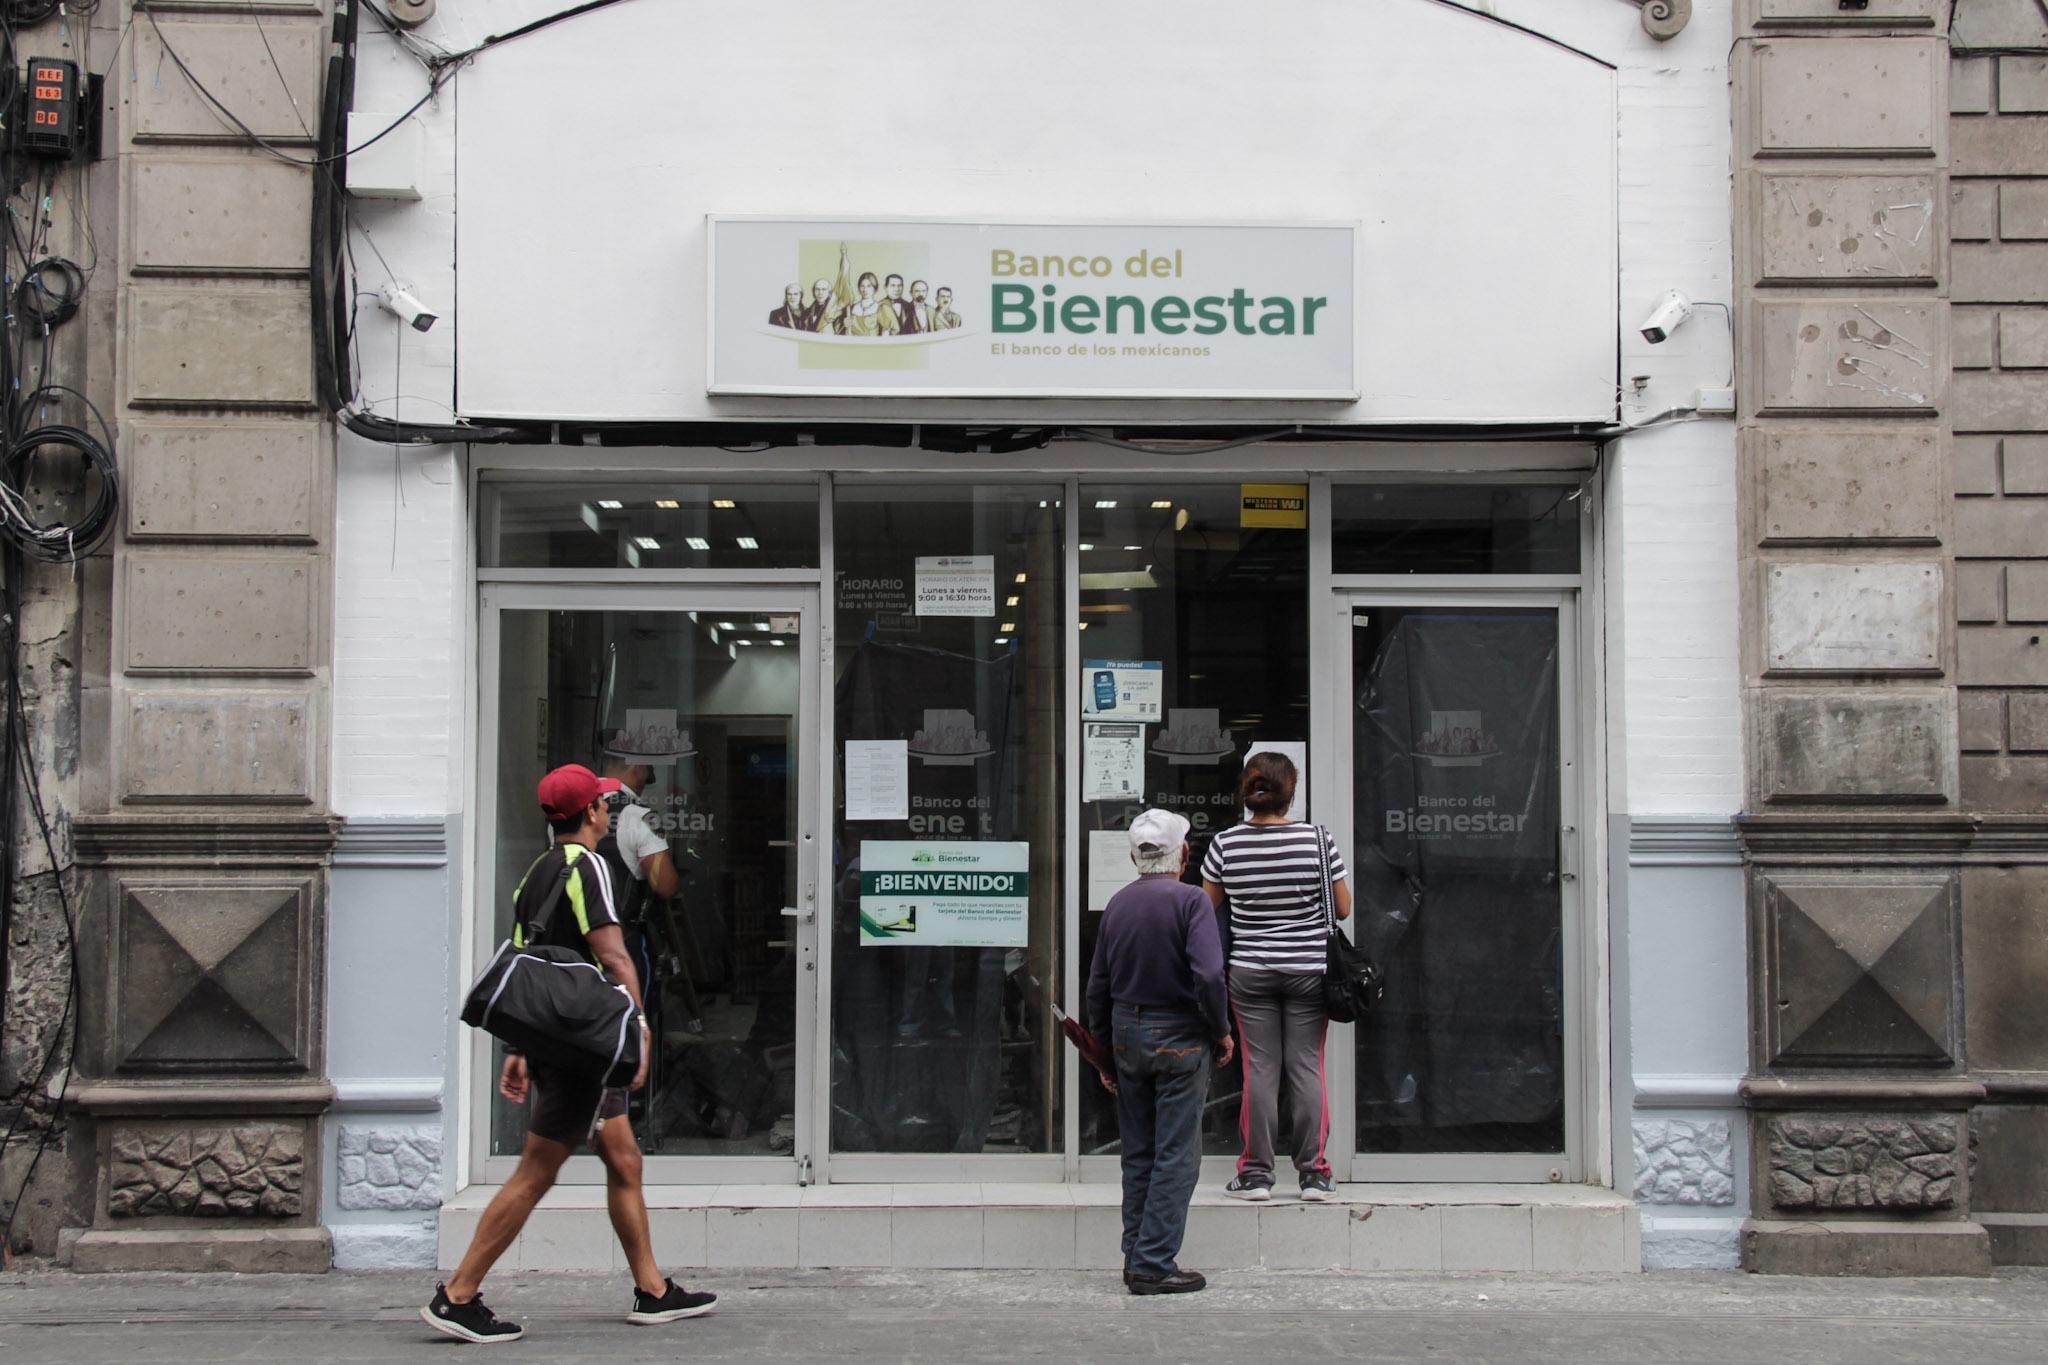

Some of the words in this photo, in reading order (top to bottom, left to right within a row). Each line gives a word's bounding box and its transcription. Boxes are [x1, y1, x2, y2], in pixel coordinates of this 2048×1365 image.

[38, 70, 62, 80] REF
[38, 88, 60, 98] 163
[991, 249, 1112, 278] Banco
[1124, 249, 1183, 278] del
[991, 283, 1327, 336] Bienestar
[990, 343, 1006, 356] El
[1011, 342, 1062, 356] banco
[1067, 343, 1088, 356] de
[1093, 343, 1116, 356] los
[1121, 343, 1211, 357] mexicanos
[1281, 499, 1301, 510] WU
[842, 579, 904, 590] HORARIO
[841, 592, 866, 600] Lunes
[886, 601, 908, 609] horas
[664, 793, 688, 805] del
[912, 796, 962, 808] Banco
[967, 797, 991, 808] del
[1157, 792, 1206, 805] Banco
[1211, 792, 1235, 805] del
[1418, 795, 1467, 807] Banco
[1472, 795, 1496, 807] del
[1386, 808, 1528, 832] Bienestar
[875, 874, 1014, 893] ¡BIENVENIDO!
